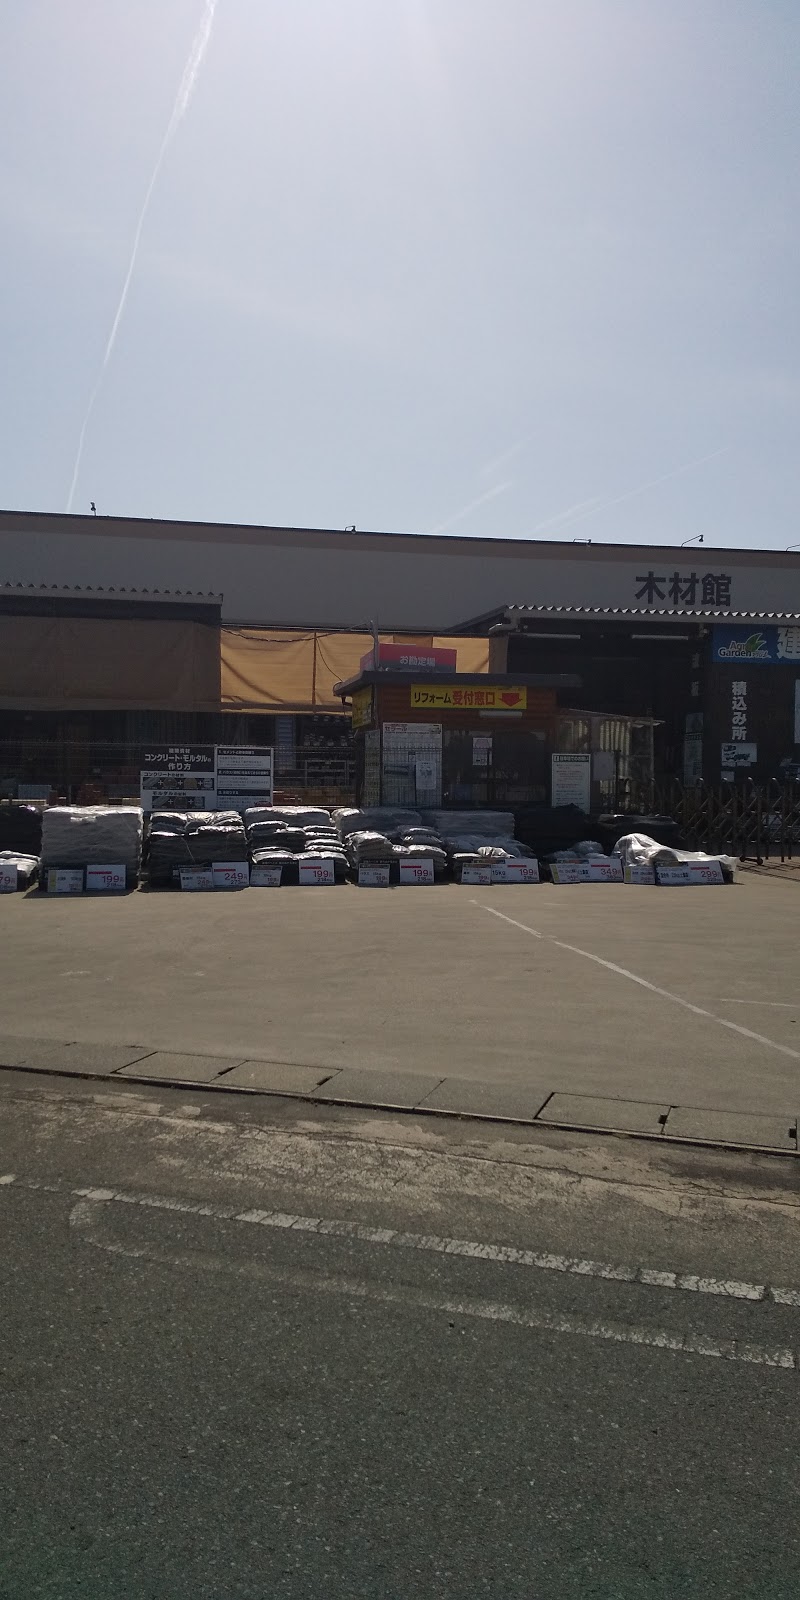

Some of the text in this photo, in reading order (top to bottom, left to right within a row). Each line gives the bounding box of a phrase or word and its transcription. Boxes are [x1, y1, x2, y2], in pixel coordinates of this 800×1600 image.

[635, 571, 732, 606] 木材館
[718, 647, 752, 657] Garden
[400, 655, 436, 667] お勘定場
[732, 681, 747, 741] 積込み所
[168, 762, 191, 771] 作り方
